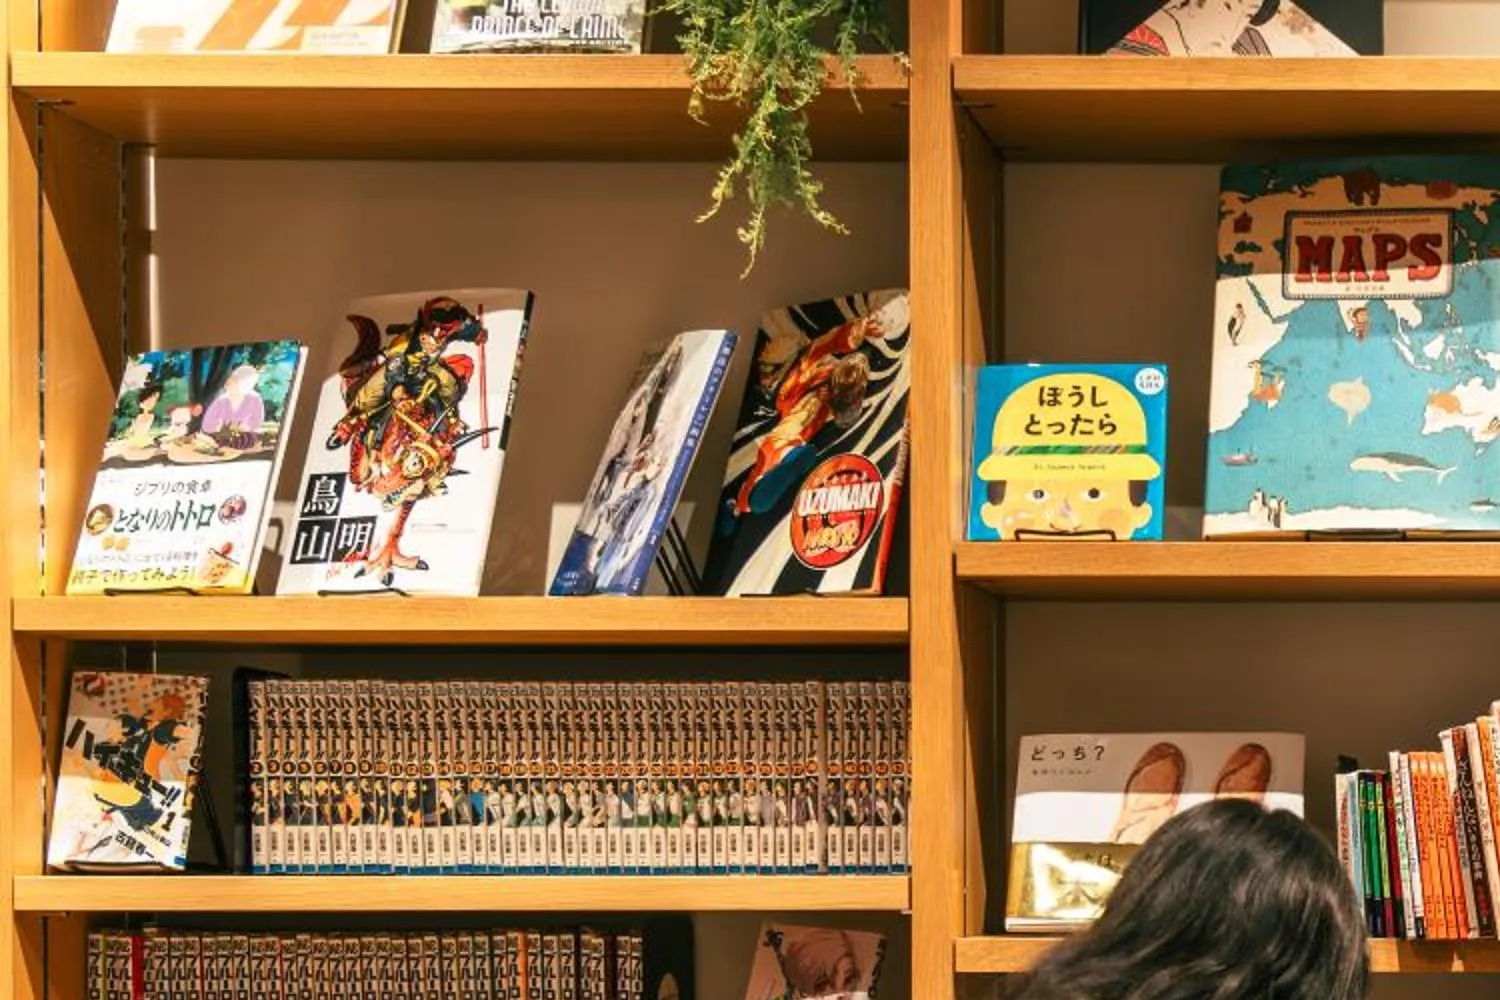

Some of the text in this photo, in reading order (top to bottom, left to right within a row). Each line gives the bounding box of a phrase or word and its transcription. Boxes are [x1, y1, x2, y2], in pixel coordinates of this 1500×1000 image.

[1294, 233, 1444, 283] MAPS
[1024, 413, 1118, 436] とったら
[134, 478, 213, 496] ジブリの食卓
[304, 476, 339, 513] 鳥
[797, 480, 883, 517] UZUMAKI
[113, 499, 217, 533] となりのトトロ
[1031, 745, 1104, 762] どっち?
